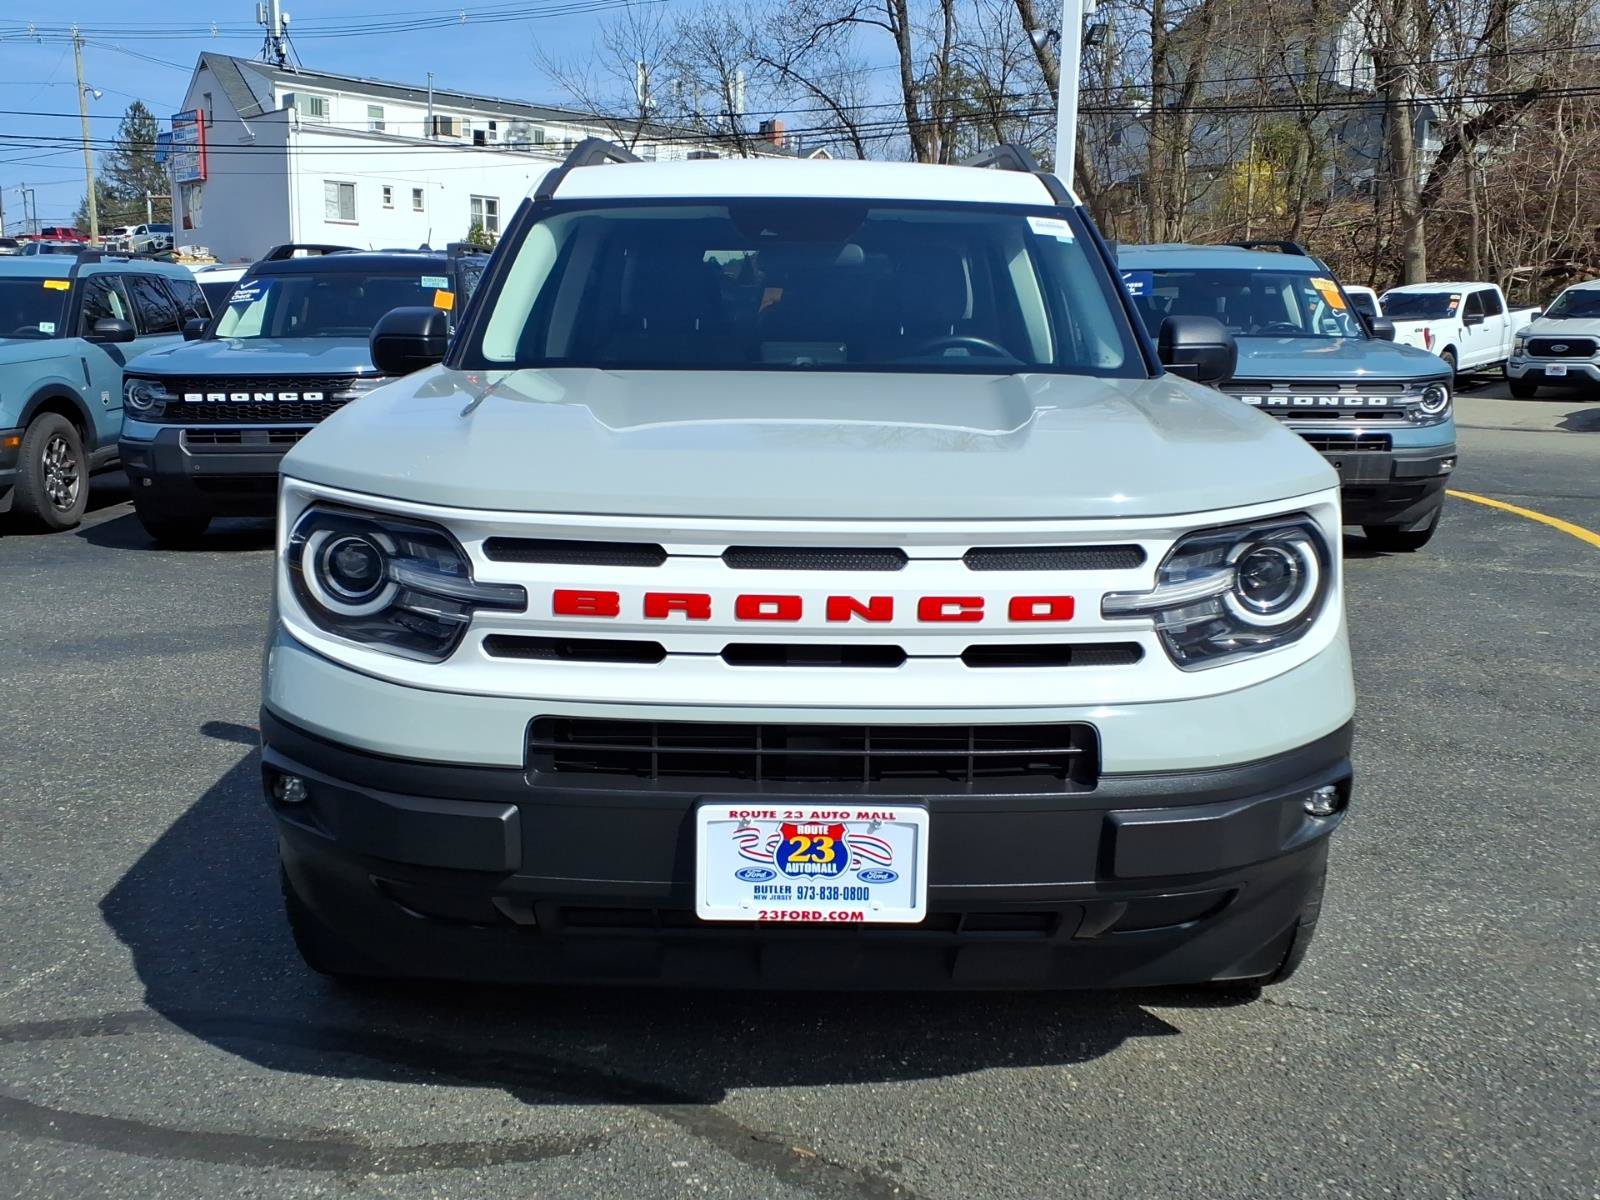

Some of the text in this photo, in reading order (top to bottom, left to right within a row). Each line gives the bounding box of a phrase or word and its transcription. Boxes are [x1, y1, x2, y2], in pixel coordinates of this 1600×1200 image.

[184, 392, 324, 402] BRONCO
[1242, 396, 1388, 406] BRONCO
[553, 589, 1075, 622] BRONCO
[729, 810, 896, 820] ROUTE 23 AUTO MALL
[796, 824, 829, 836] ROUTE
[788, 836, 836, 864] 23
[785, 862, 838, 874] AUTOMALL
[744, 870, 768, 879] Ford
[866, 871, 890, 880] Ford
[754, 885, 792, 894] BUTLER
[797, 886, 870, 902] 973-838-0800
[758, 910, 864, 921] 23FORD.COM
